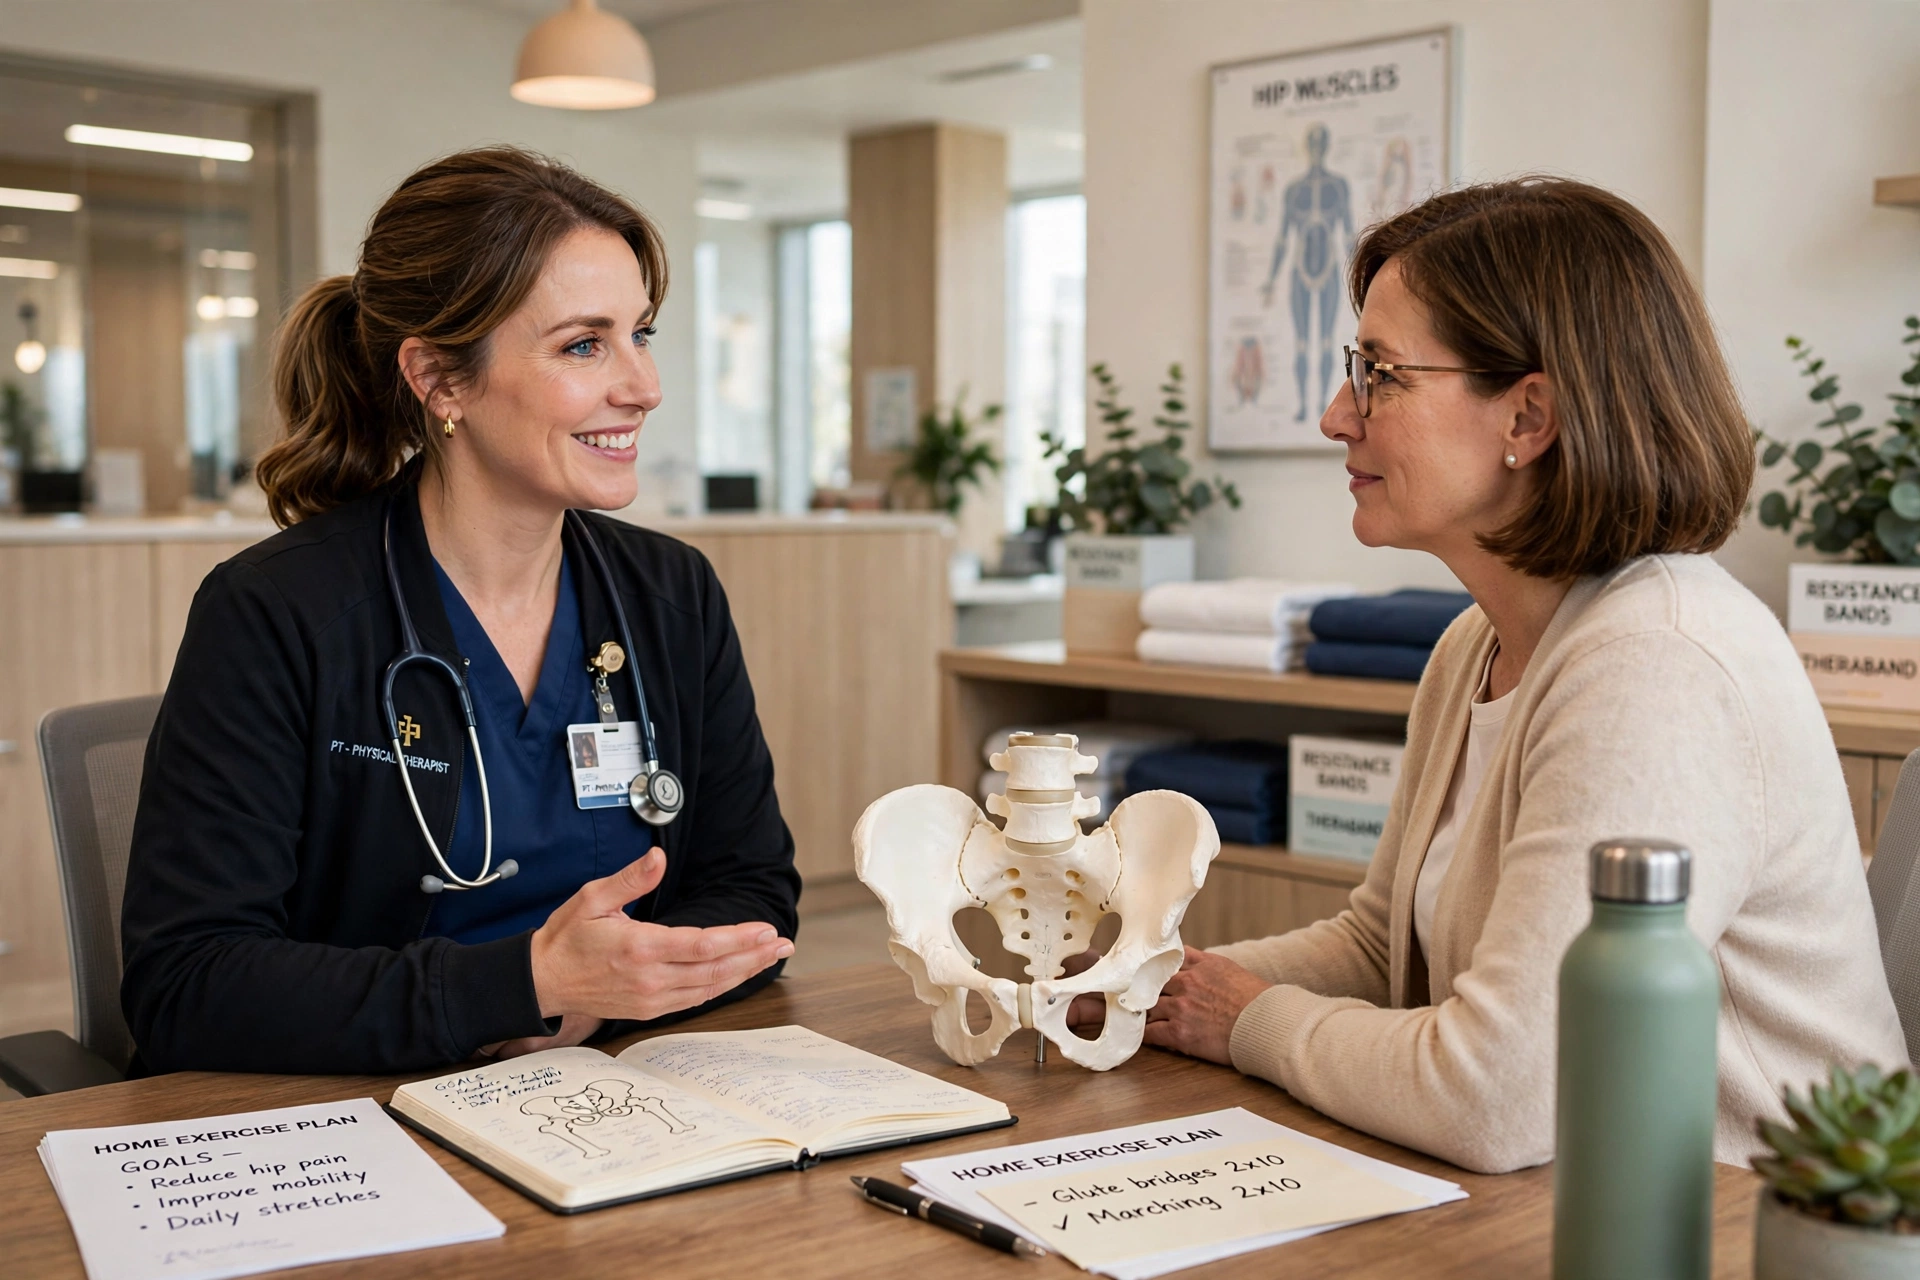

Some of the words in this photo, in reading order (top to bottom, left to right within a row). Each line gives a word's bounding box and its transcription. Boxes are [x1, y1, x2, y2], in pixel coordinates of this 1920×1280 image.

[1253, 80, 1291, 107] HIP
[1294, 63, 1399, 102] MUSCLES
[1824, 604, 1891, 626] BANDS
[1802, 652, 1917, 679] THERABAND
[330, 740, 345, 753] PT
[352, 744, 397, 764] PHYSICAL
[1303, 751, 1391, 775] RESISTANCE
[1318, 773, 1368, 793] BANDS
[94, 1137, 169, 1154] HOME
[176, 1123, 291, 1146] EXERCISE
[297, 1115, 358, 1131] PLAN
[121, 1151, 213, 1174] GOALS
[150, 1169, 238, 1190] Reduce
[249, 1163, 287, 1176] hip
[299, 1154, 348, 1171] pain
[952, 1159, 1032, 1181] HOME
[1033, 1139, 1157, 1167] EXERCISE
[1156, 1128, 1223, 1147] PLAN
[158, 1186, 259, 1209] Improve
[272, 1170, 367, 1191] mobility
[1052, 1183, 1124, 1204] Glute
[1128, 1166, 1218, 1189] bridges
[1225, 1154, 1285, 1173] 2x10
[167, 1210, 240, 1231] Daily
[258, 1189, 381, 1217] stretches
[1087, 1194, 1223, 1225] Marching
[1231, 1177, 1302, 1199] 2x10
